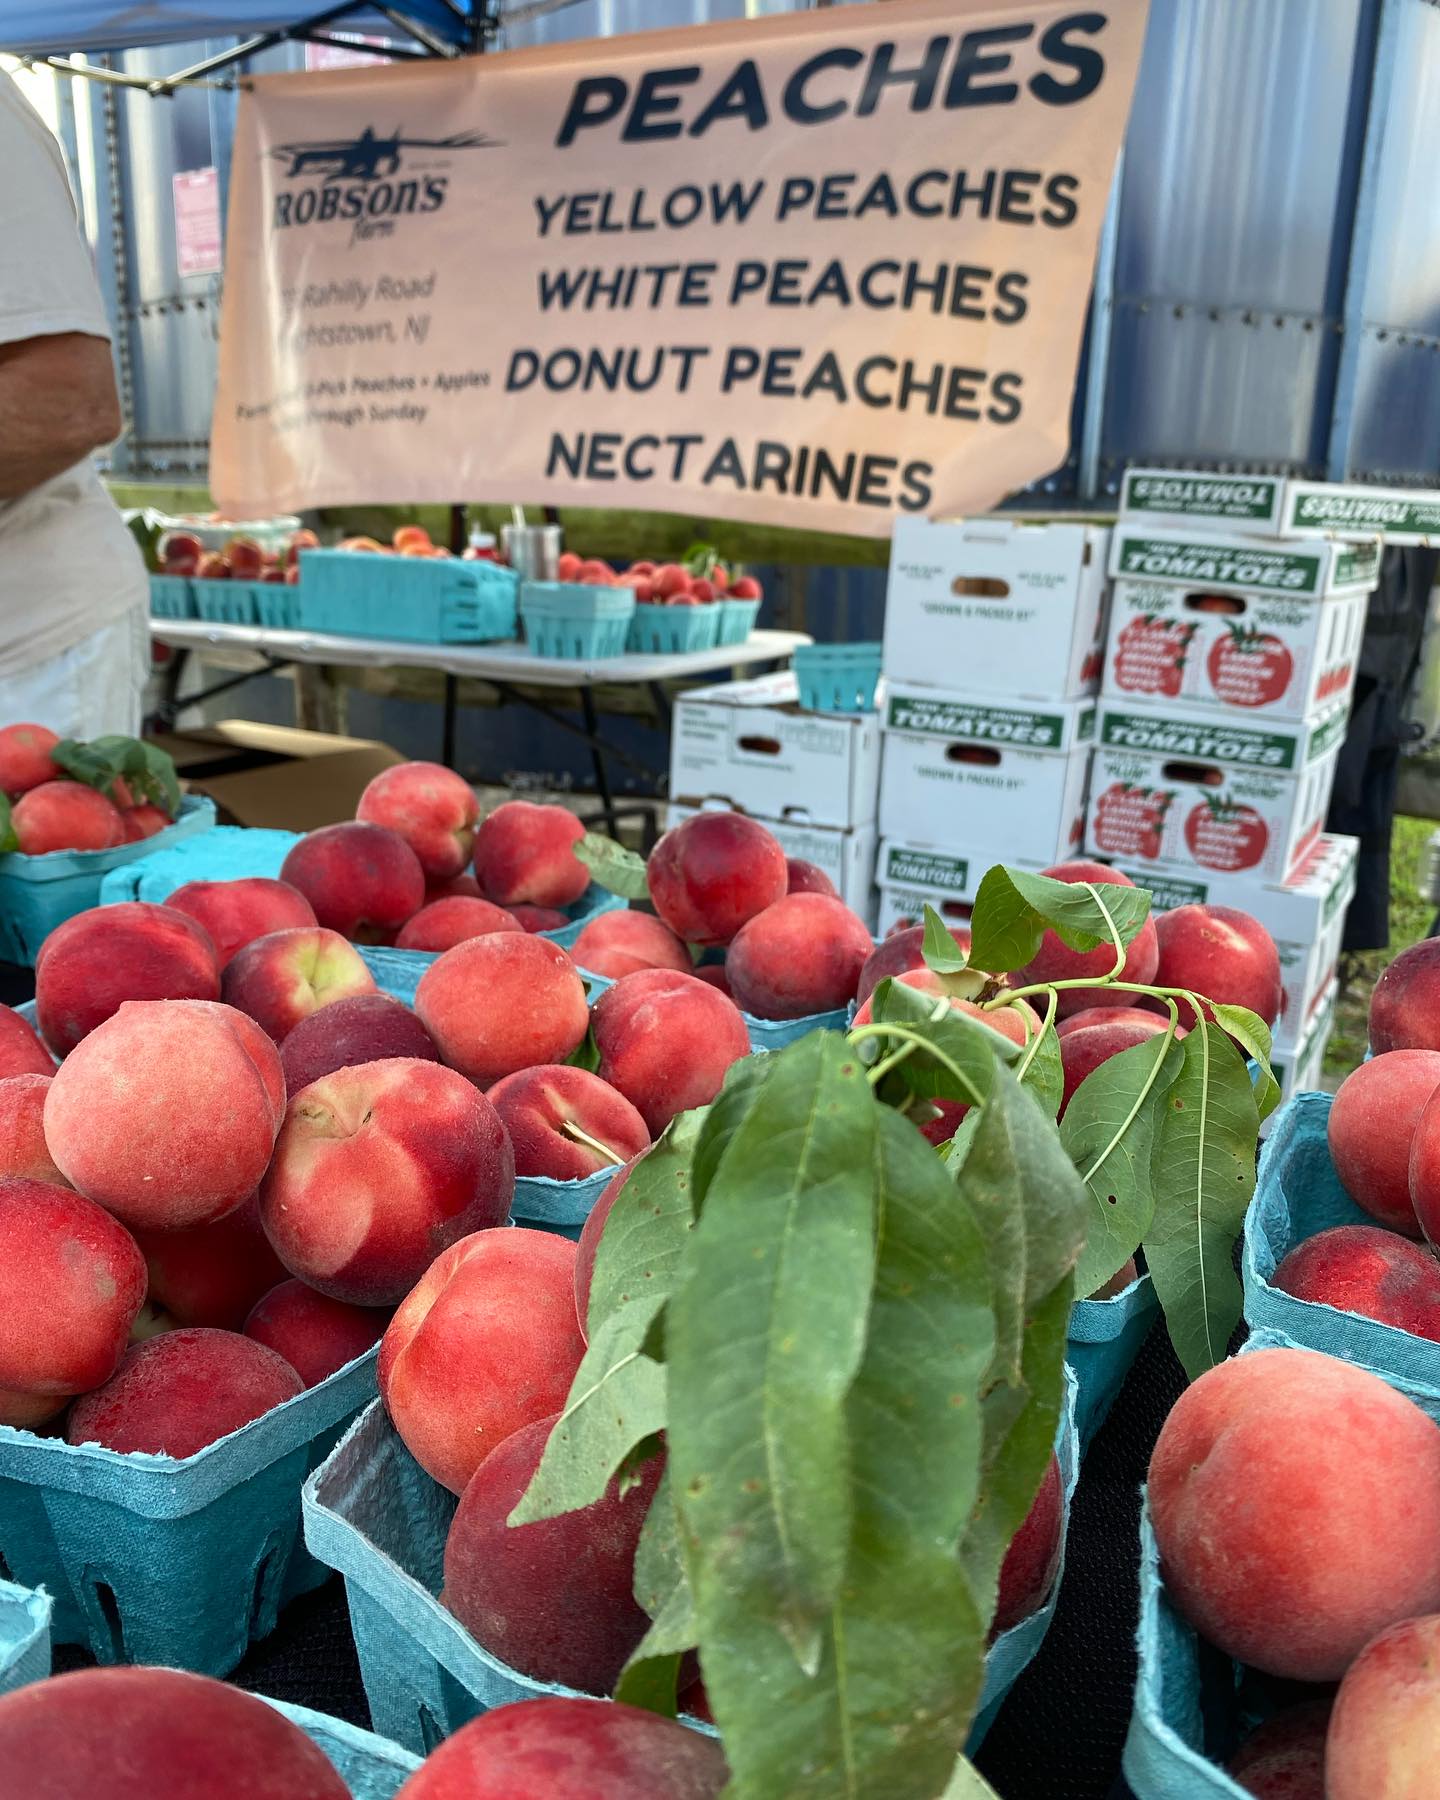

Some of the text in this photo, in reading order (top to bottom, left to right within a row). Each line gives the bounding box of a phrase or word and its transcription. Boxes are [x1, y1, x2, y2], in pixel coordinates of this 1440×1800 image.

[555, 13, 1108, 148] PEACHES
[534, 170, 1079, 237] YELLOW PEACHES
[375, 272, 436, 299] Road
[538, 260, 1030, 326] WHITE PEACHES
[505, 347, 1024, 425] DONUT PEACHES
[546, 433, 934, 513] NECTARINES
[1134, 480, 1268, 505] TOMATOES
[1300, 497, 1409, 523] TOMATOES
[1128, 552, 1308, 588] TOMATOES
[894, 709, 1054, 745] TOMATOES
[1110, 725, 1284, 766] TOMATOES
[890, 862, 963, 887] TOMATOES
